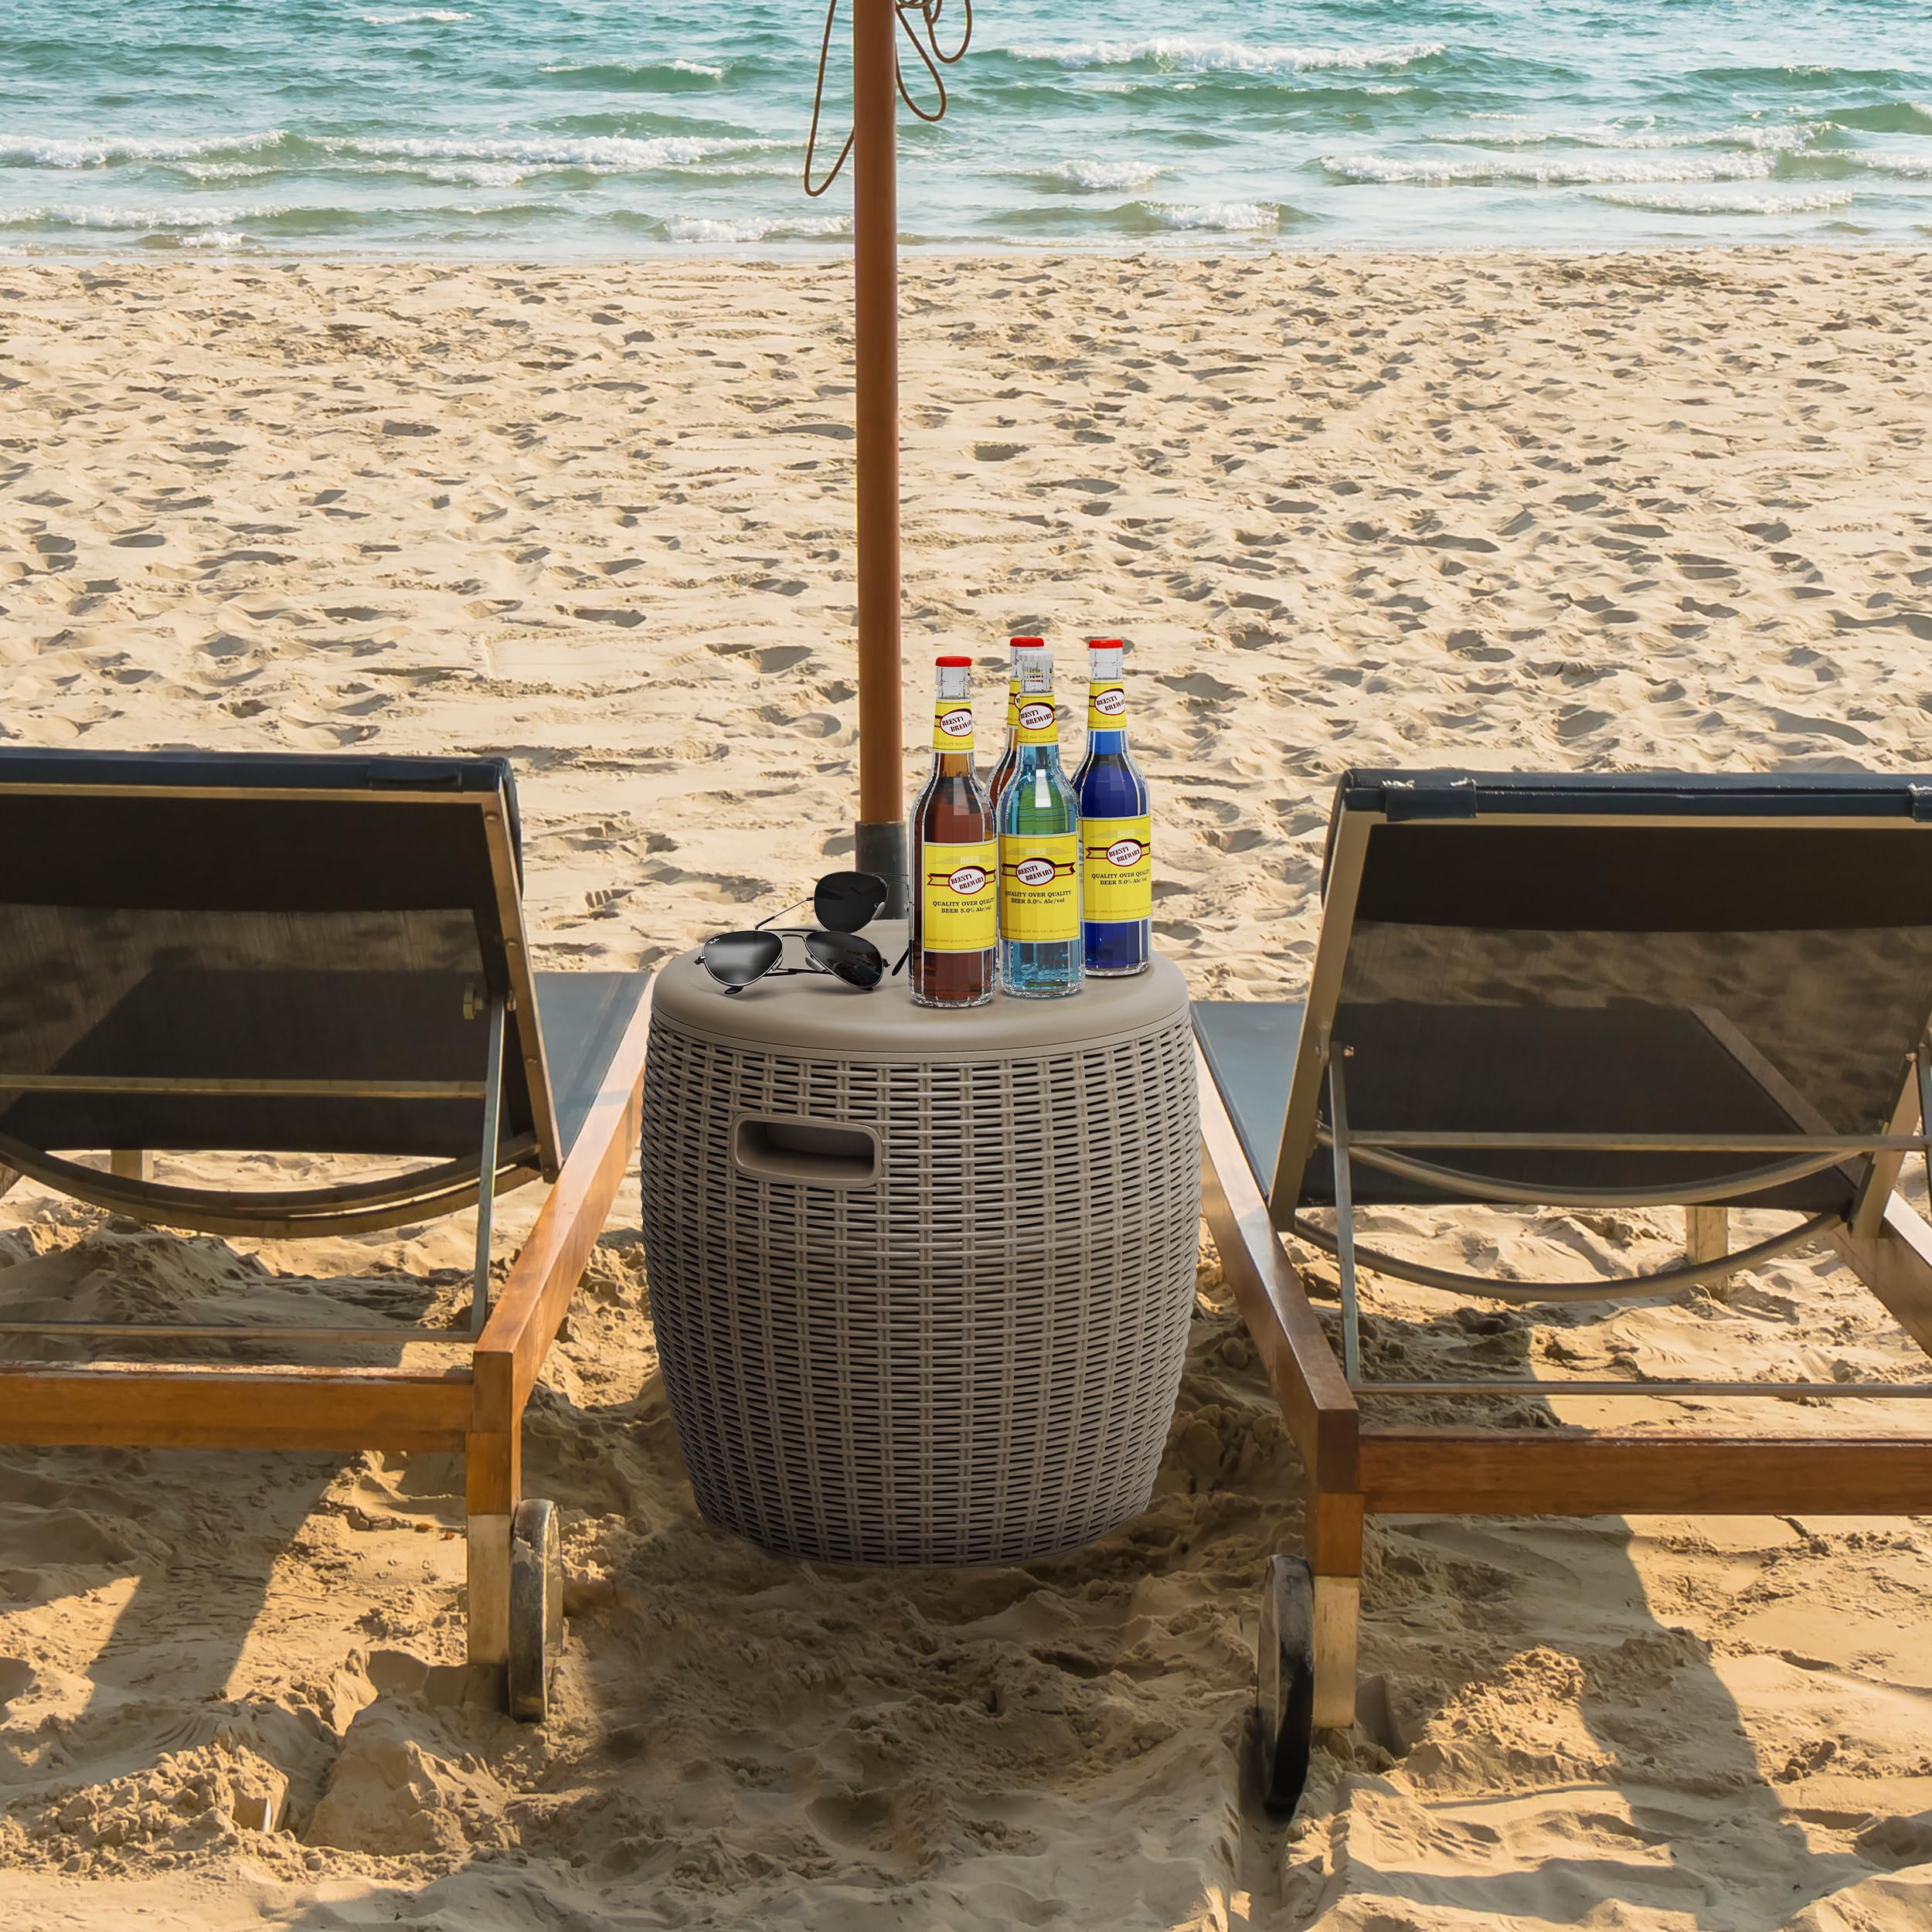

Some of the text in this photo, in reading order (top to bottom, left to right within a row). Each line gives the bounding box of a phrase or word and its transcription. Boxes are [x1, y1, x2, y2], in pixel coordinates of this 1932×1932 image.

[1097, 696, 1117, 706] BEESTY
[1020, 709, 1039, 719] BEESTY
[942, 716, 964, 726] BEESTY
[1108, 846, 1129, 858] BEESTY
[1116, 849, 1140, 862] BREWARY
[1017, 865, 1039, 876] BEESTY
[1025, 869, 1053, 881] BREWARY
[951, 873, 972, 885] BEESTY
[959, 876, 984, 890] BREWARY
